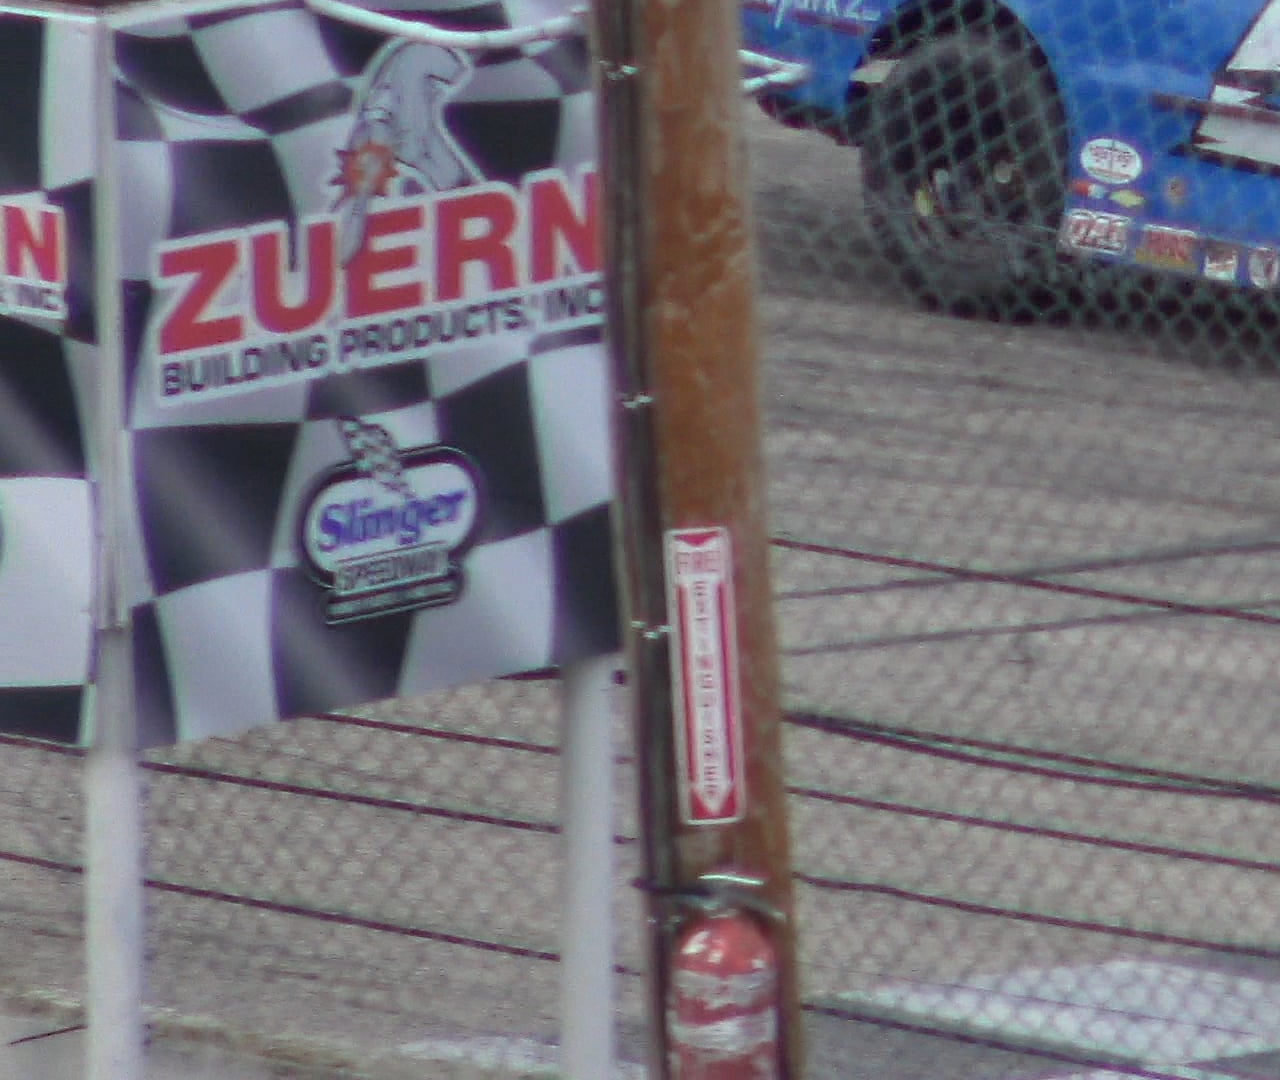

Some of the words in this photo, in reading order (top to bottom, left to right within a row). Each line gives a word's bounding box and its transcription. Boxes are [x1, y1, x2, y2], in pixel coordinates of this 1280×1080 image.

[158, 170, 602, 356] ZUERN
[163, 333, 330, 397] BUILDING
[318, 490, 467, 554] Slinger
[338, 548, 449, 591] SPEEDWAY
